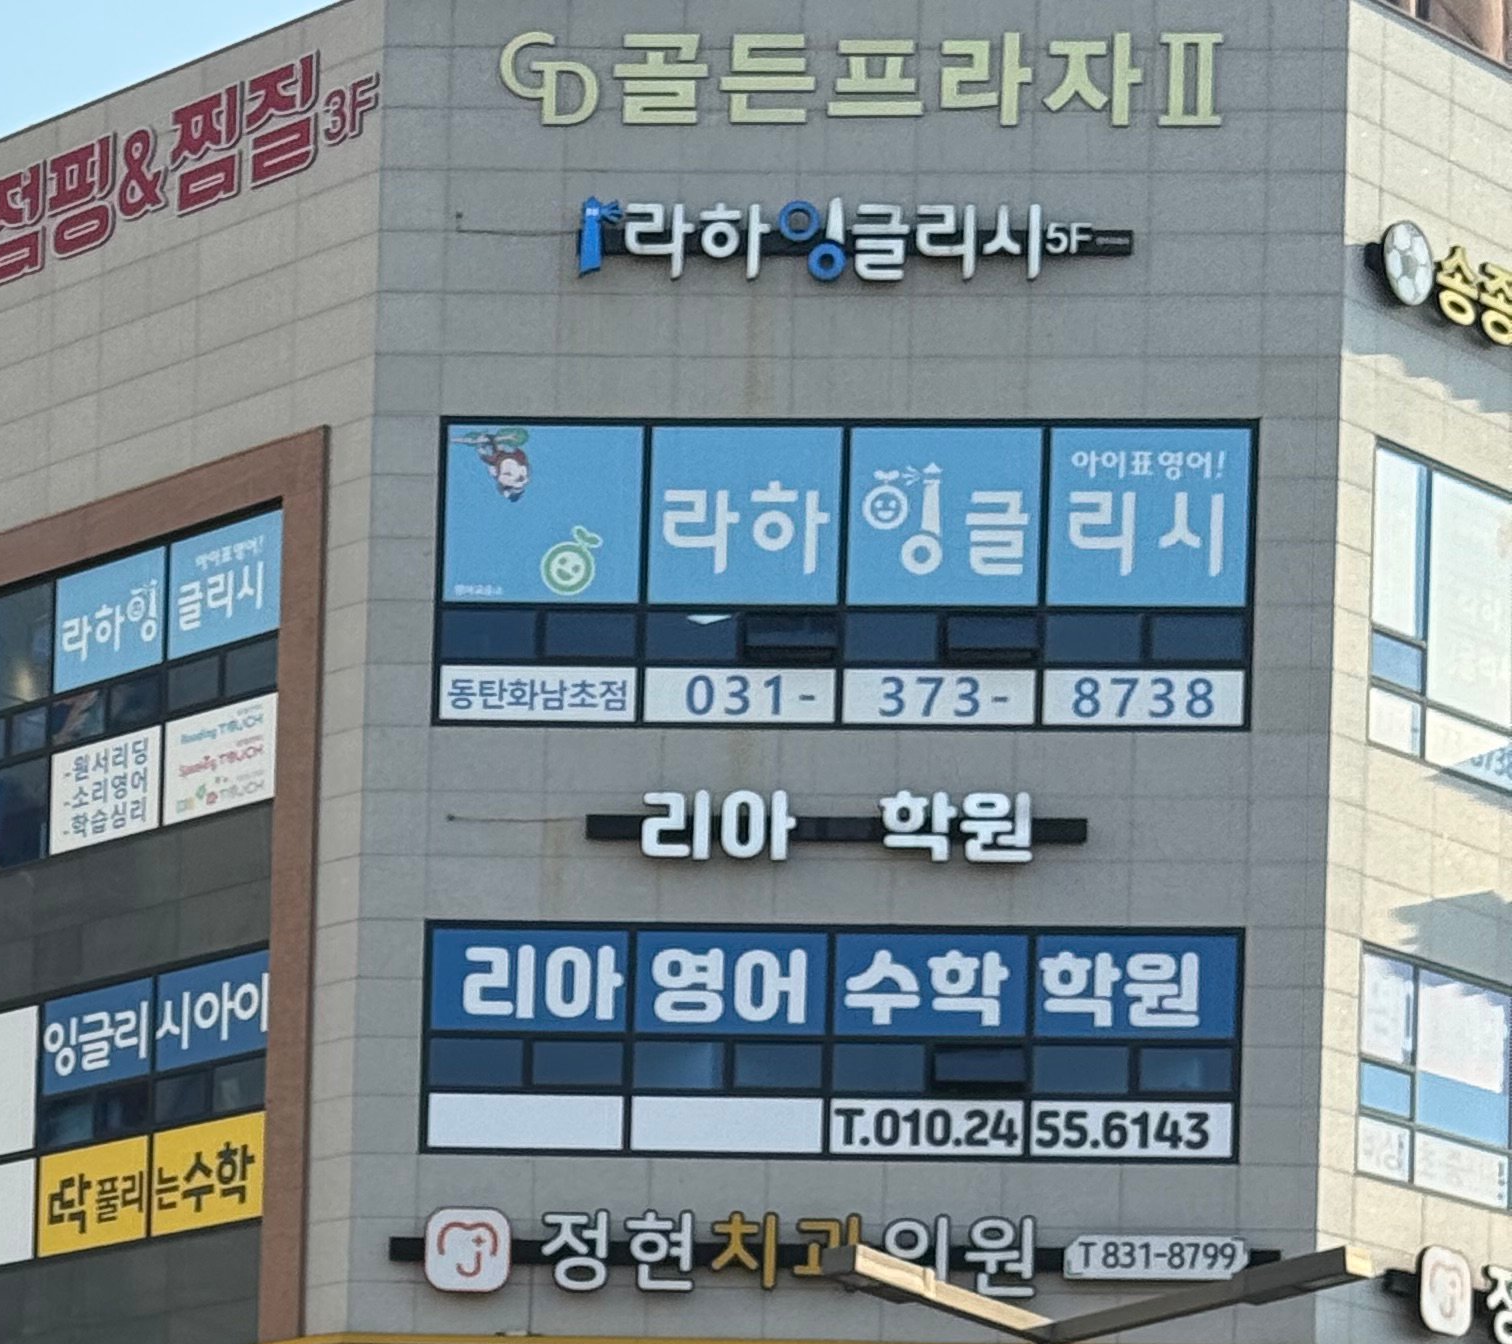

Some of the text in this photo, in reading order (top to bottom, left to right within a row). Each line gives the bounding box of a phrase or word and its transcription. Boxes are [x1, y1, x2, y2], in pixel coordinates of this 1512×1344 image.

[322, 71, 381, 146] 3F
[624, 197, 1094, 282] 라하잉글리시 5F
[447, 677, 629, 715] 동탄화남초점
[1071, 675, 1216, 719] 8738
[641, 789, 1034, 865] 리아 학원
[462, 944, 1201, 1028] 리아 영어 수학 학원
